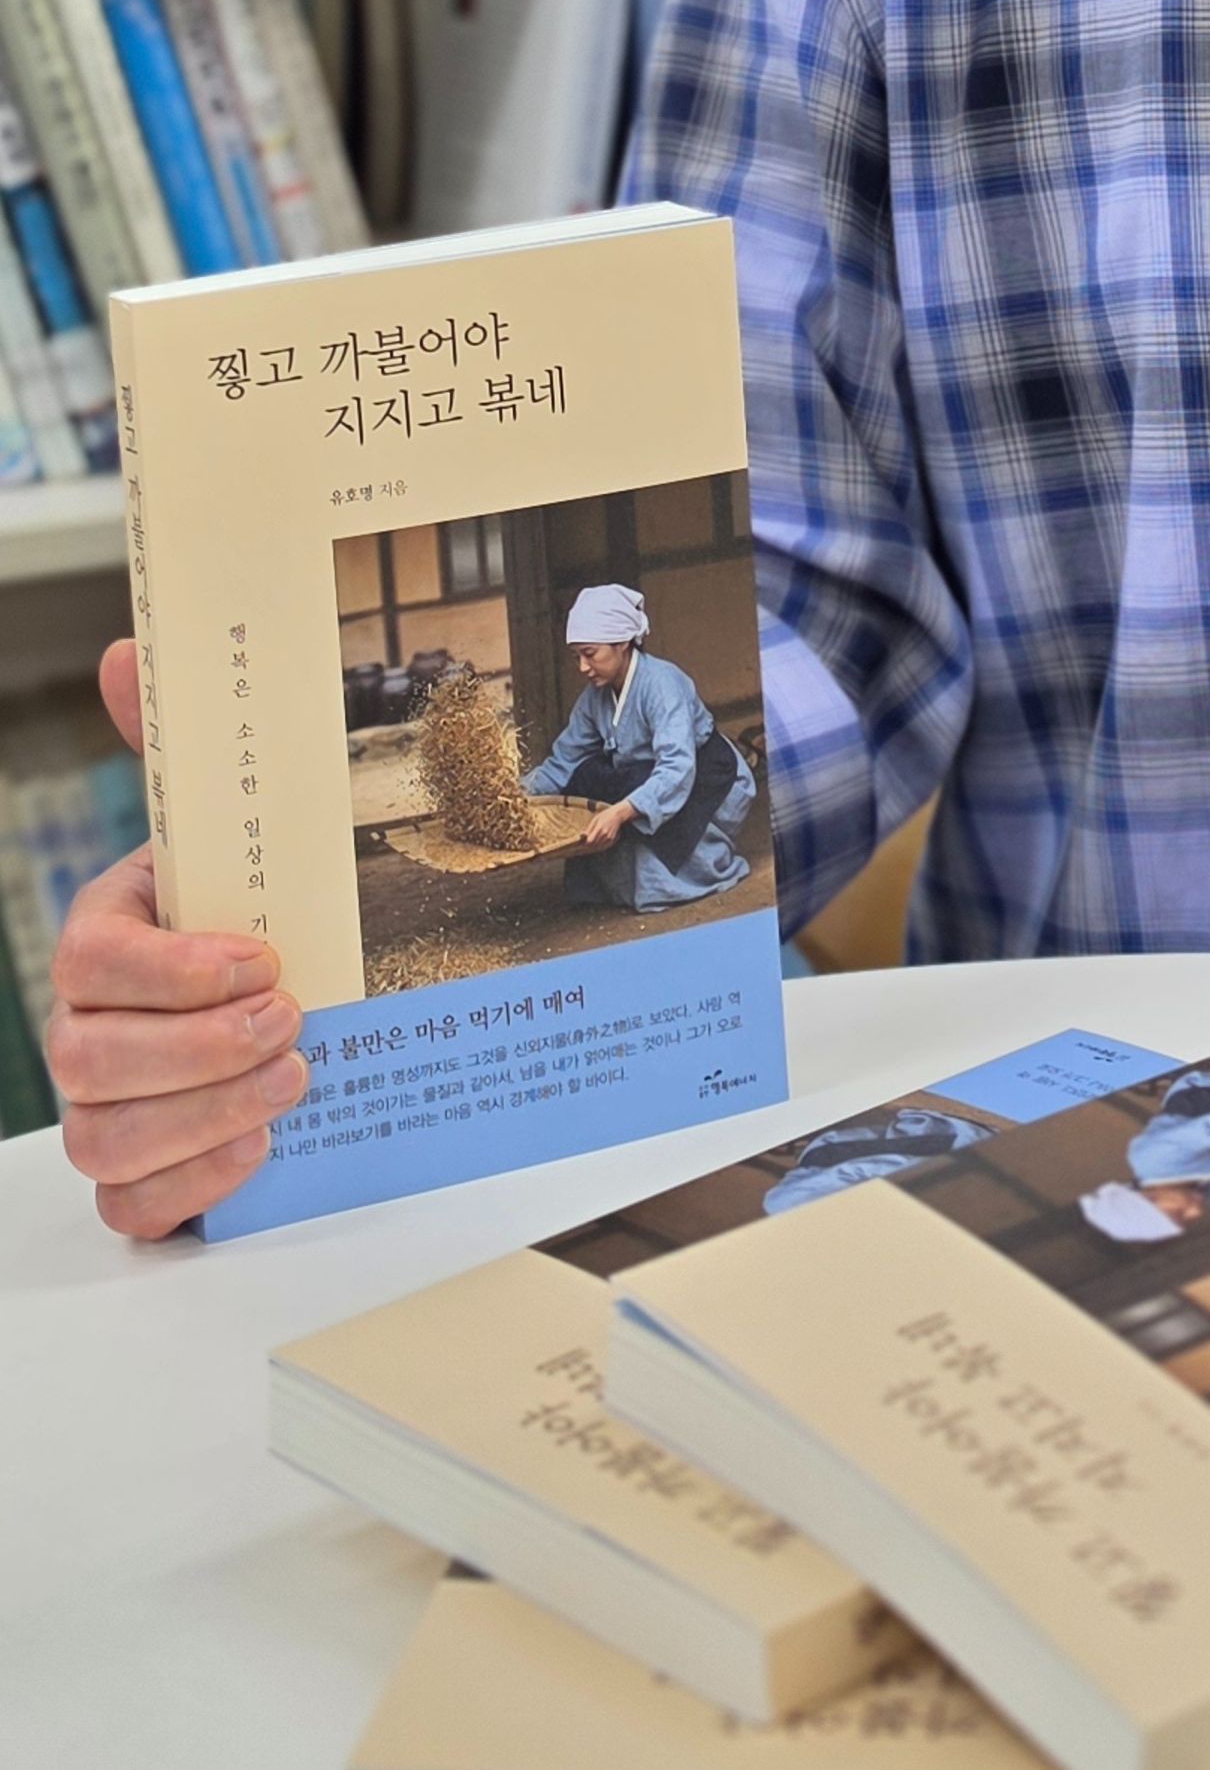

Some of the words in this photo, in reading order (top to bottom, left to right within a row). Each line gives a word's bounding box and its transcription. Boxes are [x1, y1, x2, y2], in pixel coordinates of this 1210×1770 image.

[207, 346, 303, 401] 찧고
[320, 311, 511, 382] 까불어야
[323, 386, 464, 446] 지지고
[478, 365, 567, 424] 볶네
[329, 484, 374, 506] 유호명
[379, 478, 408, 499] 지음
[229, 623, 253, 698] 행복은
[236, 721, 259, 796] 소소한
[243, 817, 266, 891] 일상의
[339, 1026, 408, 1061] 불만은
[415, 1015, 461, 1043] 마음
[469, 996, 535, 1031] 먹기에
[543, 985, 585, 1015] 매여
[343, 1072, 385, 1096] 훌륭한
[391, 1057, 461, 1085] 명성까지도
[466, 1046, 507, 1068] 그것을
[650, 1004, 692, 1027] 보았다.
[697, 996, 722, 1015] 사람
[728, 991, 742, 1006] 역
[287, 1116, 302, 1132] 내
[327, 1104, 356, 1124] 밖의
[362, 1092, 417, 1118] 것이기는
[422, 1080, 465, 1103] 물질과
[552, 1053, 579, 1071] 내가
[643, 1031, 681, 1052] 것이나
[686, 1022, 712, 1041] 그가
[717, 1015, 743, 1034] 오로
[270, 1145, 284, 1161] 지
[289, 1138, 317, 1156] 나만
[322, 1121, 392, 1150] 바라보기를
[398, 1111, 440, 1132] 바라는
[445, 1101, 472, 1121] 마음
[477, 1094, 504, 1113] 역시
[510, 1081, 562, 1108] 경계해야
[568, 1077, 581, 1094] 할
[585, 1066, 630, 1087] 바이다.
